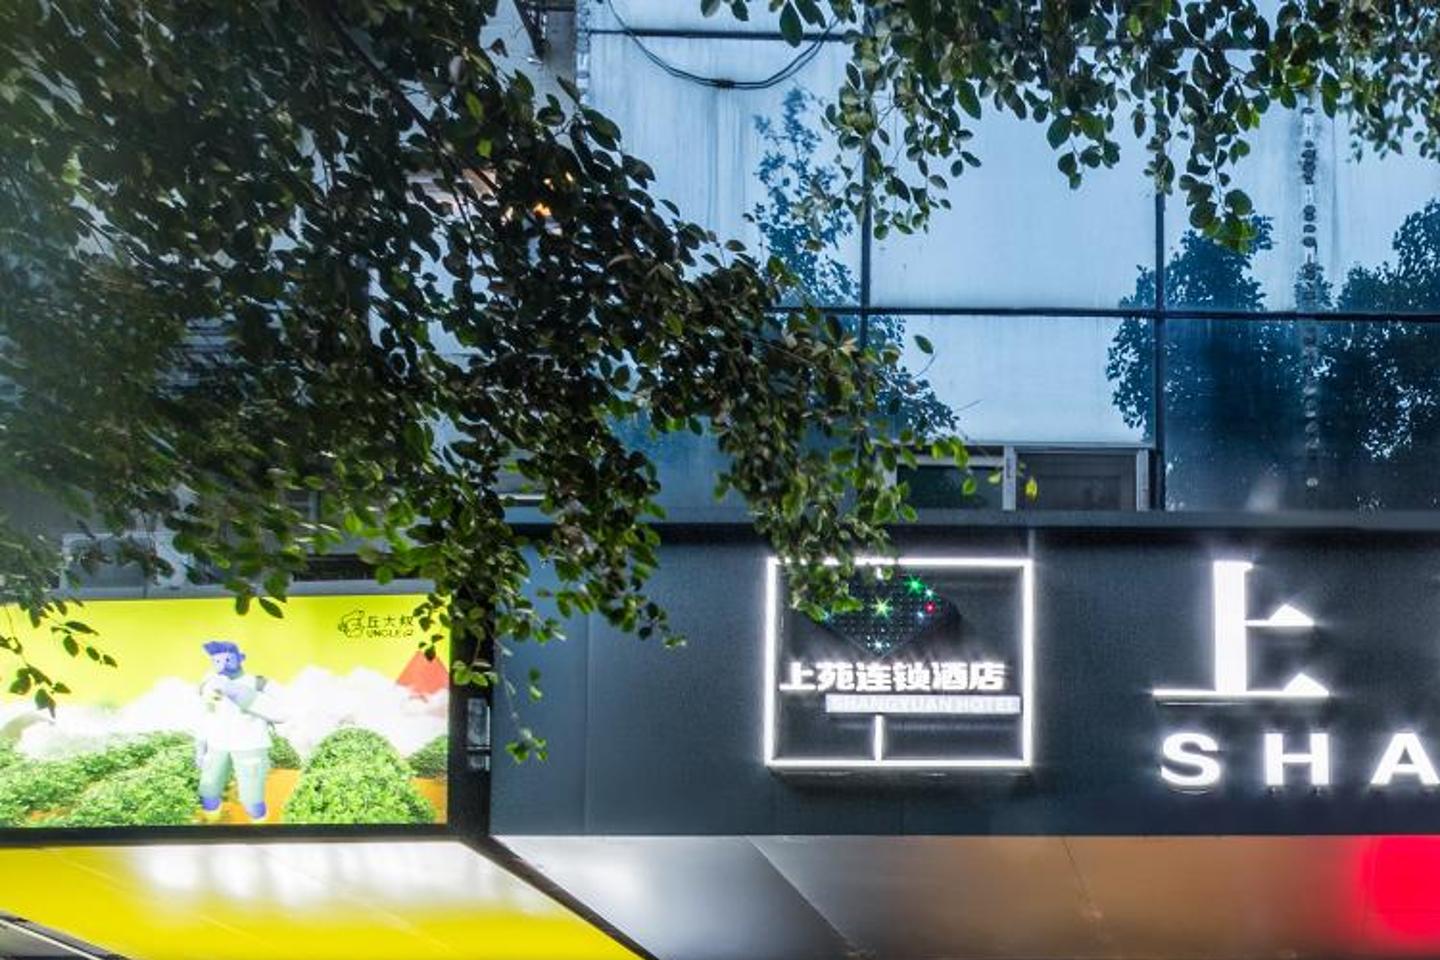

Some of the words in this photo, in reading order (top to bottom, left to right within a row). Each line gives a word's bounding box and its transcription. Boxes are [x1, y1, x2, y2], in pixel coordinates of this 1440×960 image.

[778, 660, 1006, 692] 上苑连锁酒店
